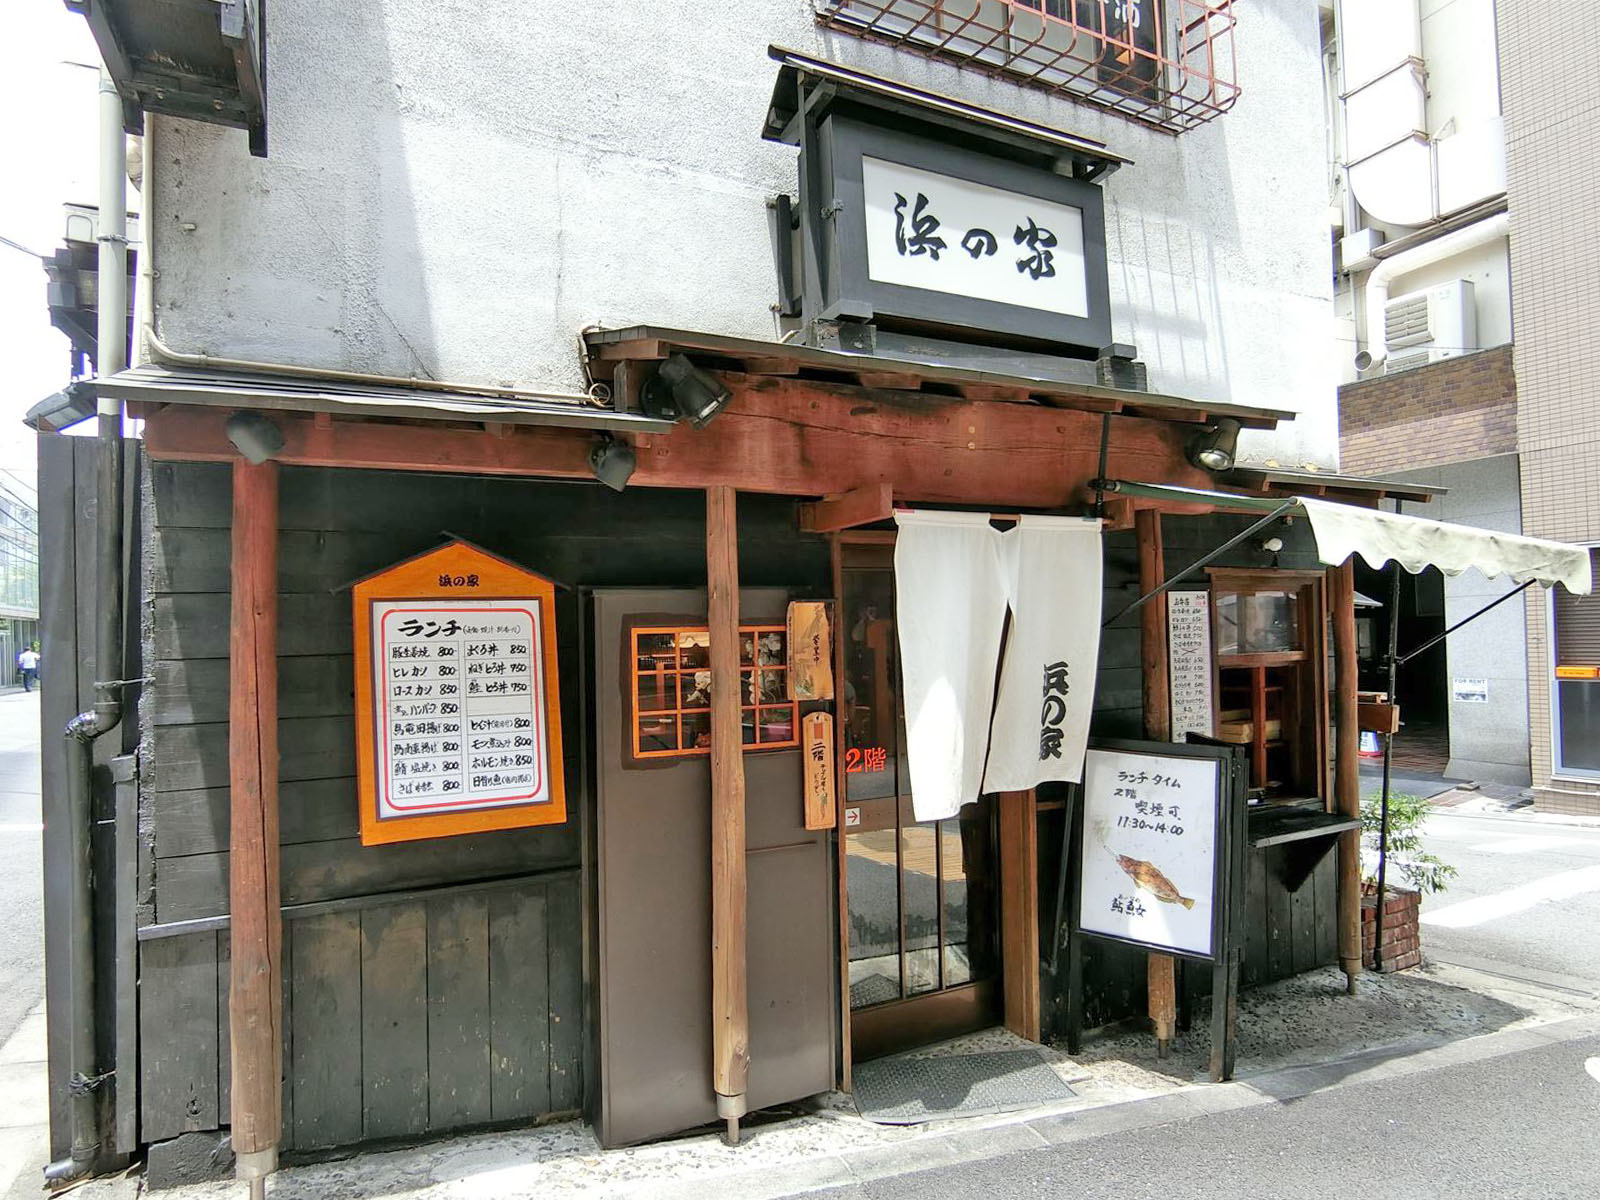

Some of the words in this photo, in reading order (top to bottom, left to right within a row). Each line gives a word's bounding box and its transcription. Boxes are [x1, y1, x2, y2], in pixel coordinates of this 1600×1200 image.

[894, 192, 1058, 281] 浜の家
[438, 574, 480, 587] 浜の家
[398, 619, 462, 638] ランチ
[467, 644, 499, 657] まぐろ丼
[510, 644, 527, 654] 850
[468, 661, 507, 675] ねぎとろ丼
[510, 663, 527, 673] 750
[511, 683, 528, 692] 750
[440, 703, 458, 714] 850
[514, 736, 532, 748] 800
[811, 742, 826, 762] 二階
[515, 755, 532, 766] 850
[845, 747, 887, 773] 2階
[1113, 788, 1137, 799] 2階
